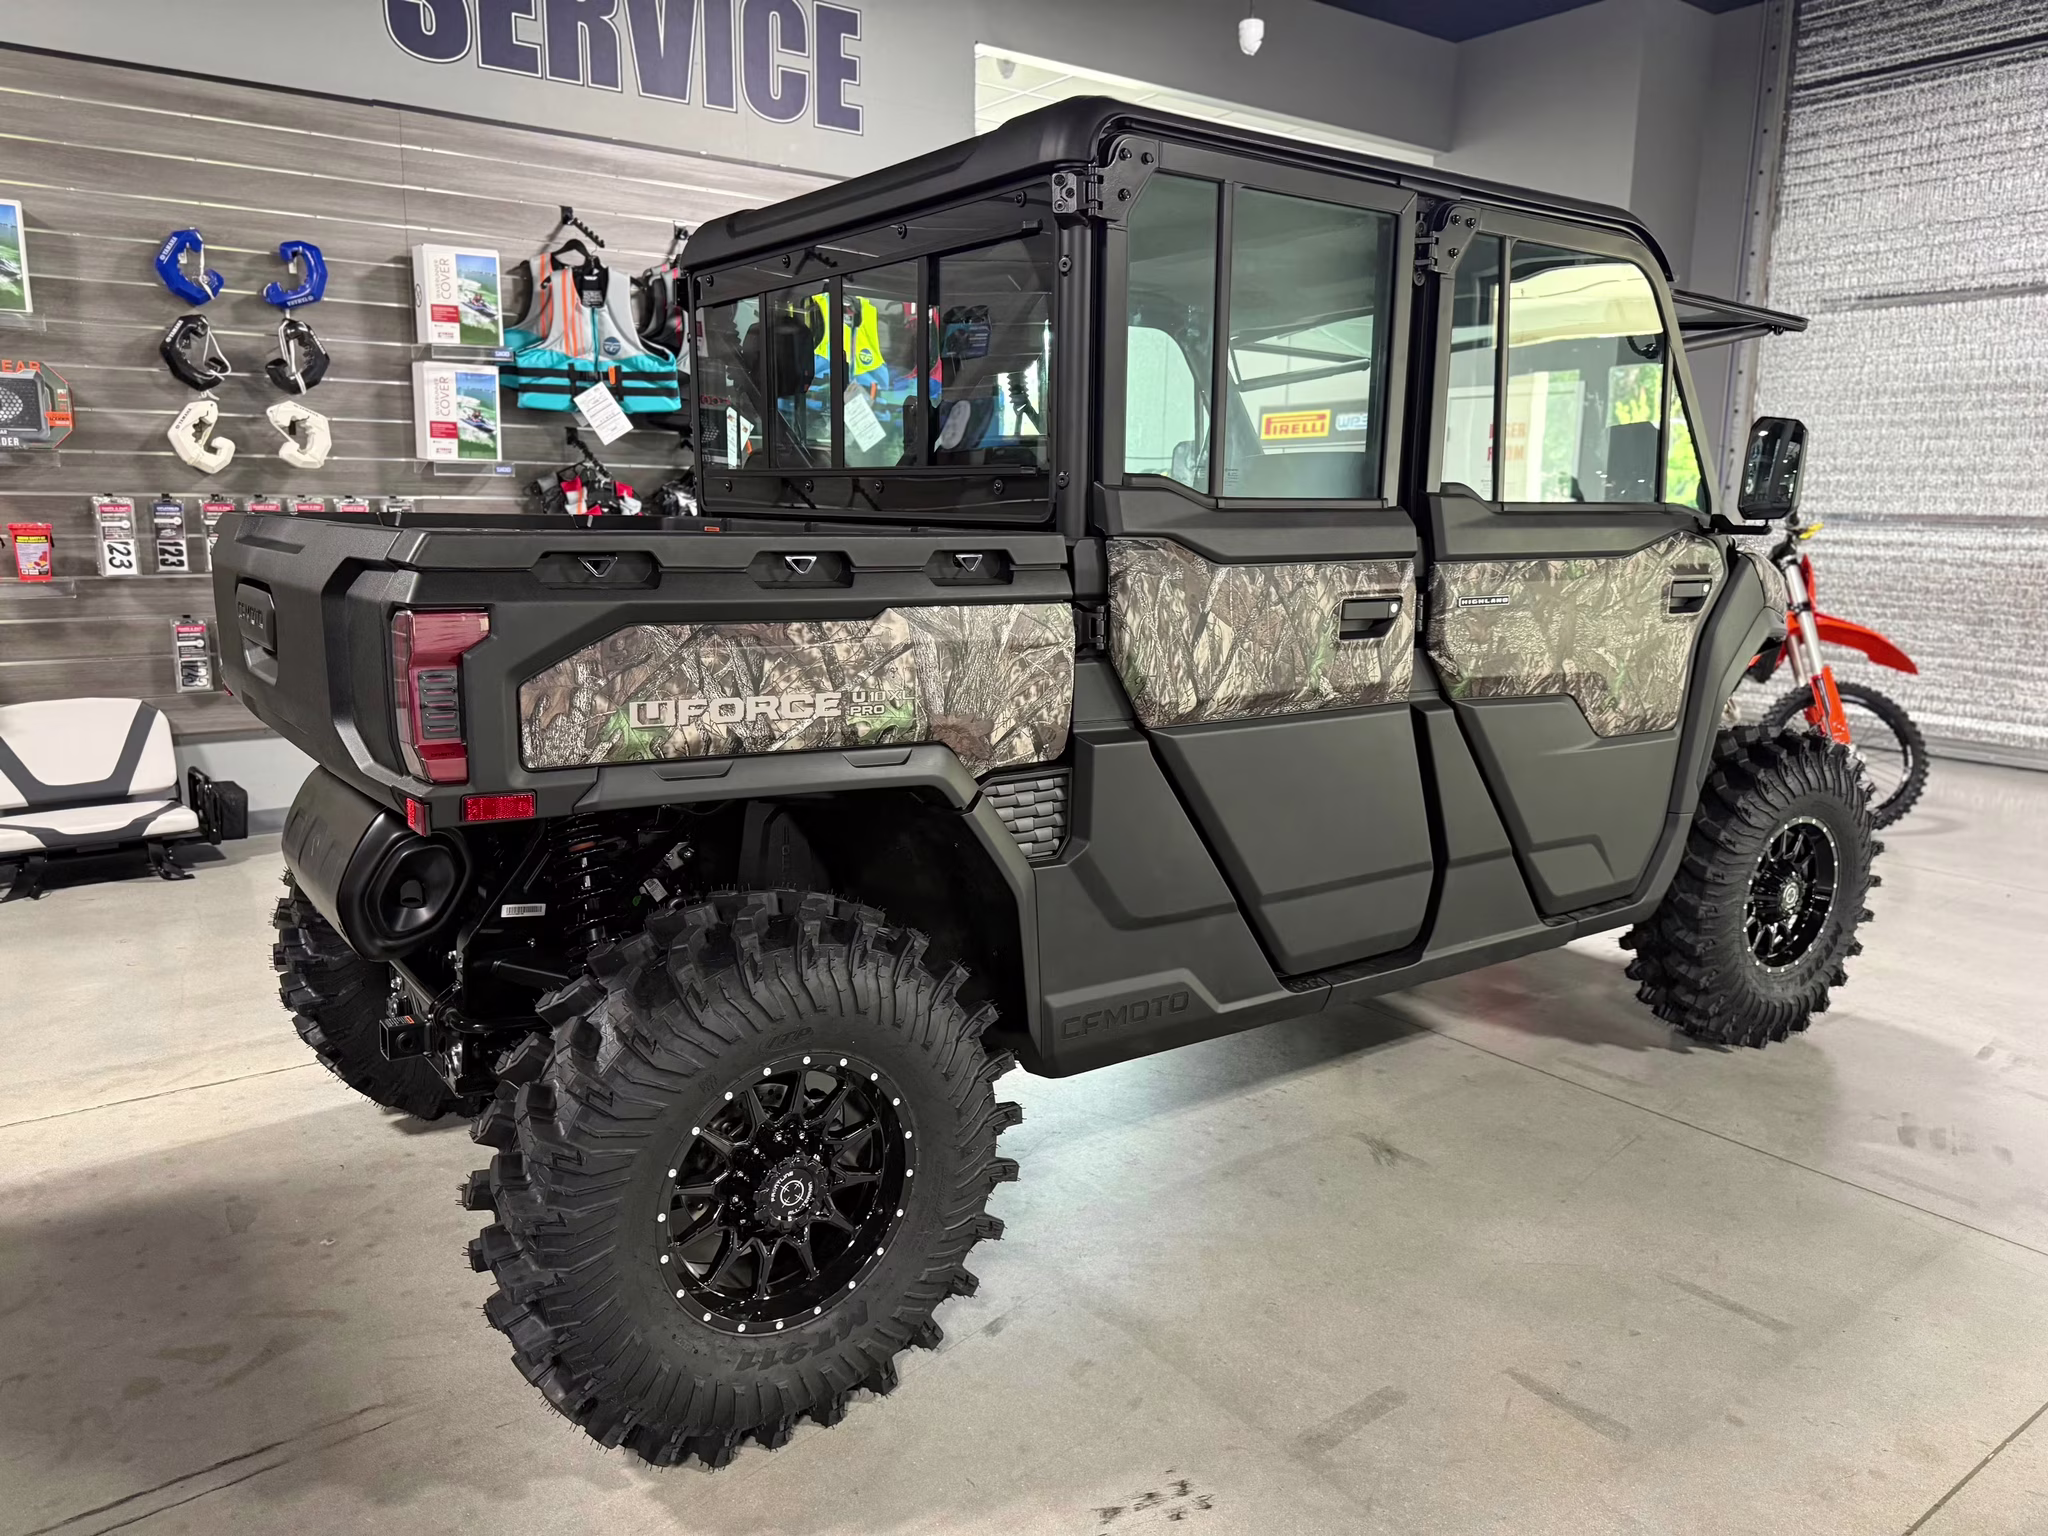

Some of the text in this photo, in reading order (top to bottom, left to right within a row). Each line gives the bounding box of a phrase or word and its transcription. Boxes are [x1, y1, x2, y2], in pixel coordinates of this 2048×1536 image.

[439, 258, 452, 300] COVER
[438, 376, 451, 417] COVER
[1265, 413, 1328, 436] PIRELLI
[106, 541, 133, 569] 123
[159, 541, 186, 568] 123
[1461, 597, 1509, 605] HIGHLAND
[181, 660, 208, 687] 123
[850, 704, 886, 716] PRO
[1060, 991, 1189, 1041] CFMOTO
